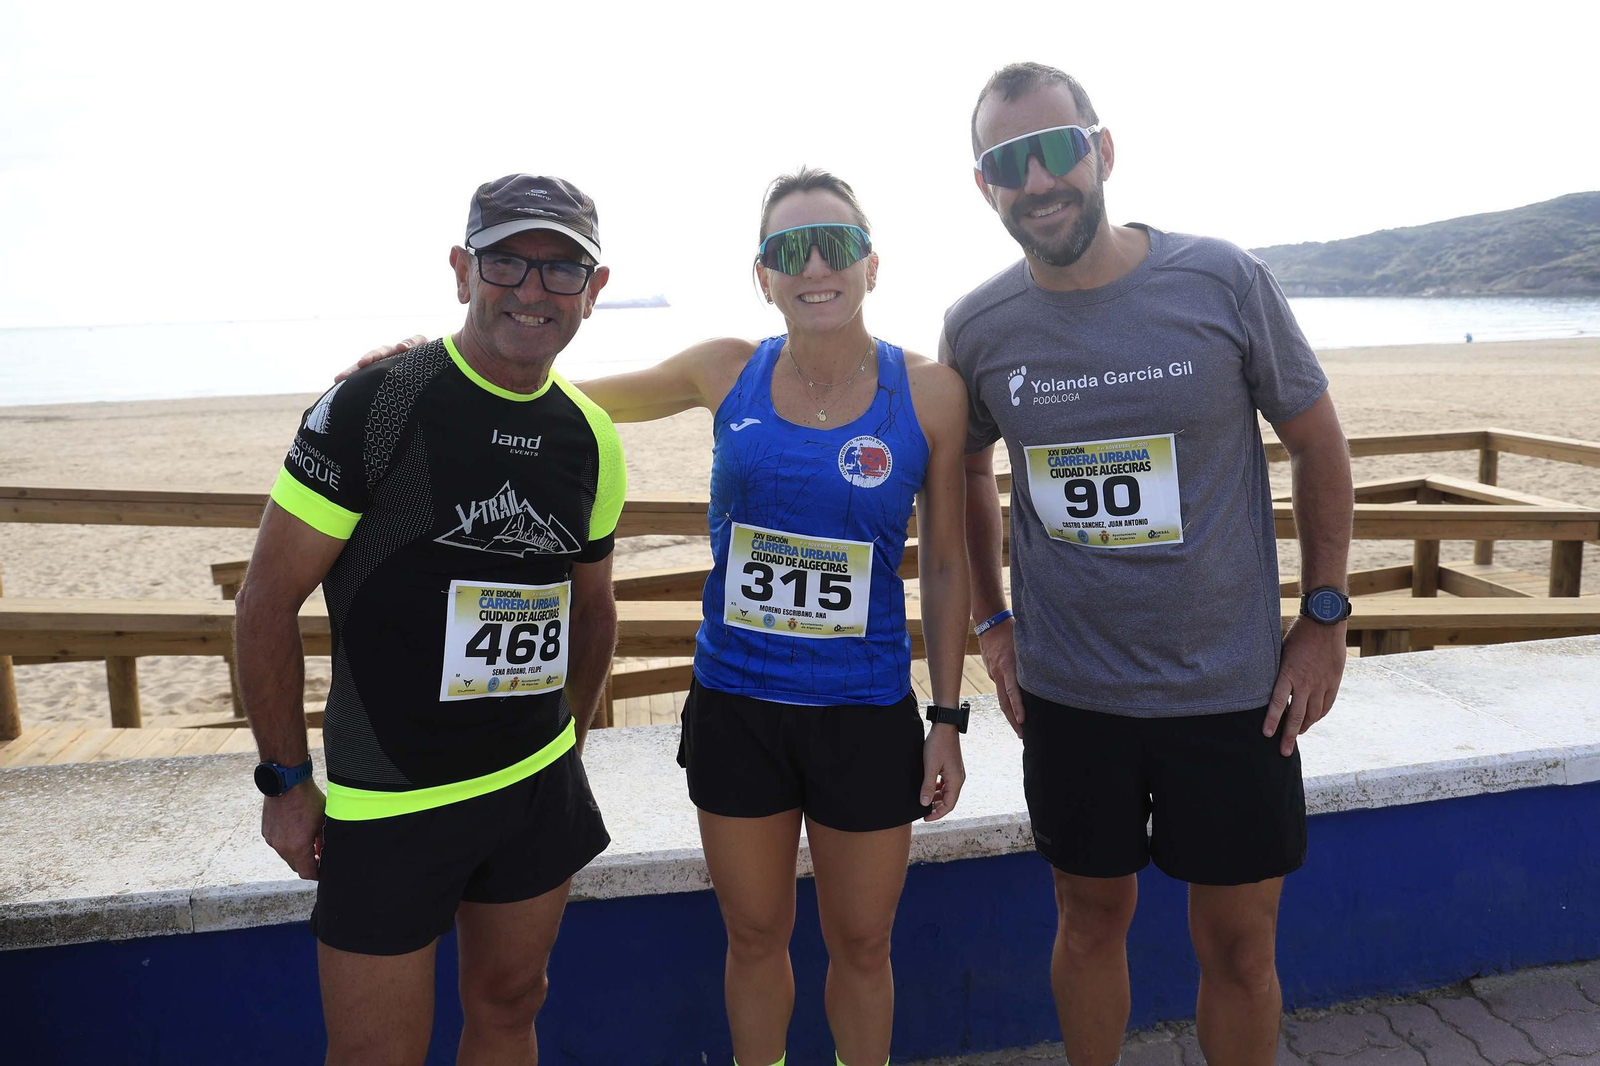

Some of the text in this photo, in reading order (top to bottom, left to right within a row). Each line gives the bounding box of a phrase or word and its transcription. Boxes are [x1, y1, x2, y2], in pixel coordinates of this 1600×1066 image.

[1030, 361, 1193, 394] Yolanda García Gil
[1032, 392, 1080, 405] PODÓLOGA
[491, 429, 542, 450] land
[301, 441, 342, 474] CHARAXES
[509, 448, 539, 457] EVENTS
[1047, 448, 1150, 467] CARRERA URBANA
[1060, 446, 1085, 455] EDICIÓN
[1050, 461, 1151, 479] CIUDAD DE ALGECIRAS
[1064, 475, 1141, 519] 90
[1062, 518, 1149, 529] CASTRO SANCHEZ, JUAN ANTONIO
[753, 532, 788, 544] XXV EDICIÓN
[751, 539, 848, 563] CARRERA URBANA
[750, 550, 848, 574] CIUDAD DE ALGECIRAS
[481, 589, 521, 598] XXV EDICIÓN
[741, 561, 852, 611] 315
[478, 596, 559, 610] CARRERA URBANA
[479, 608, 559, 622] CIUDAD DE ALGECIRAS
[759, 604, 827, 620] MORENO ESCRIBANO, ANA
[465, 619, 561, 666] 468
[492, 668, 505, 676] SENA
[528, 665, 542, 674] FELIPE
